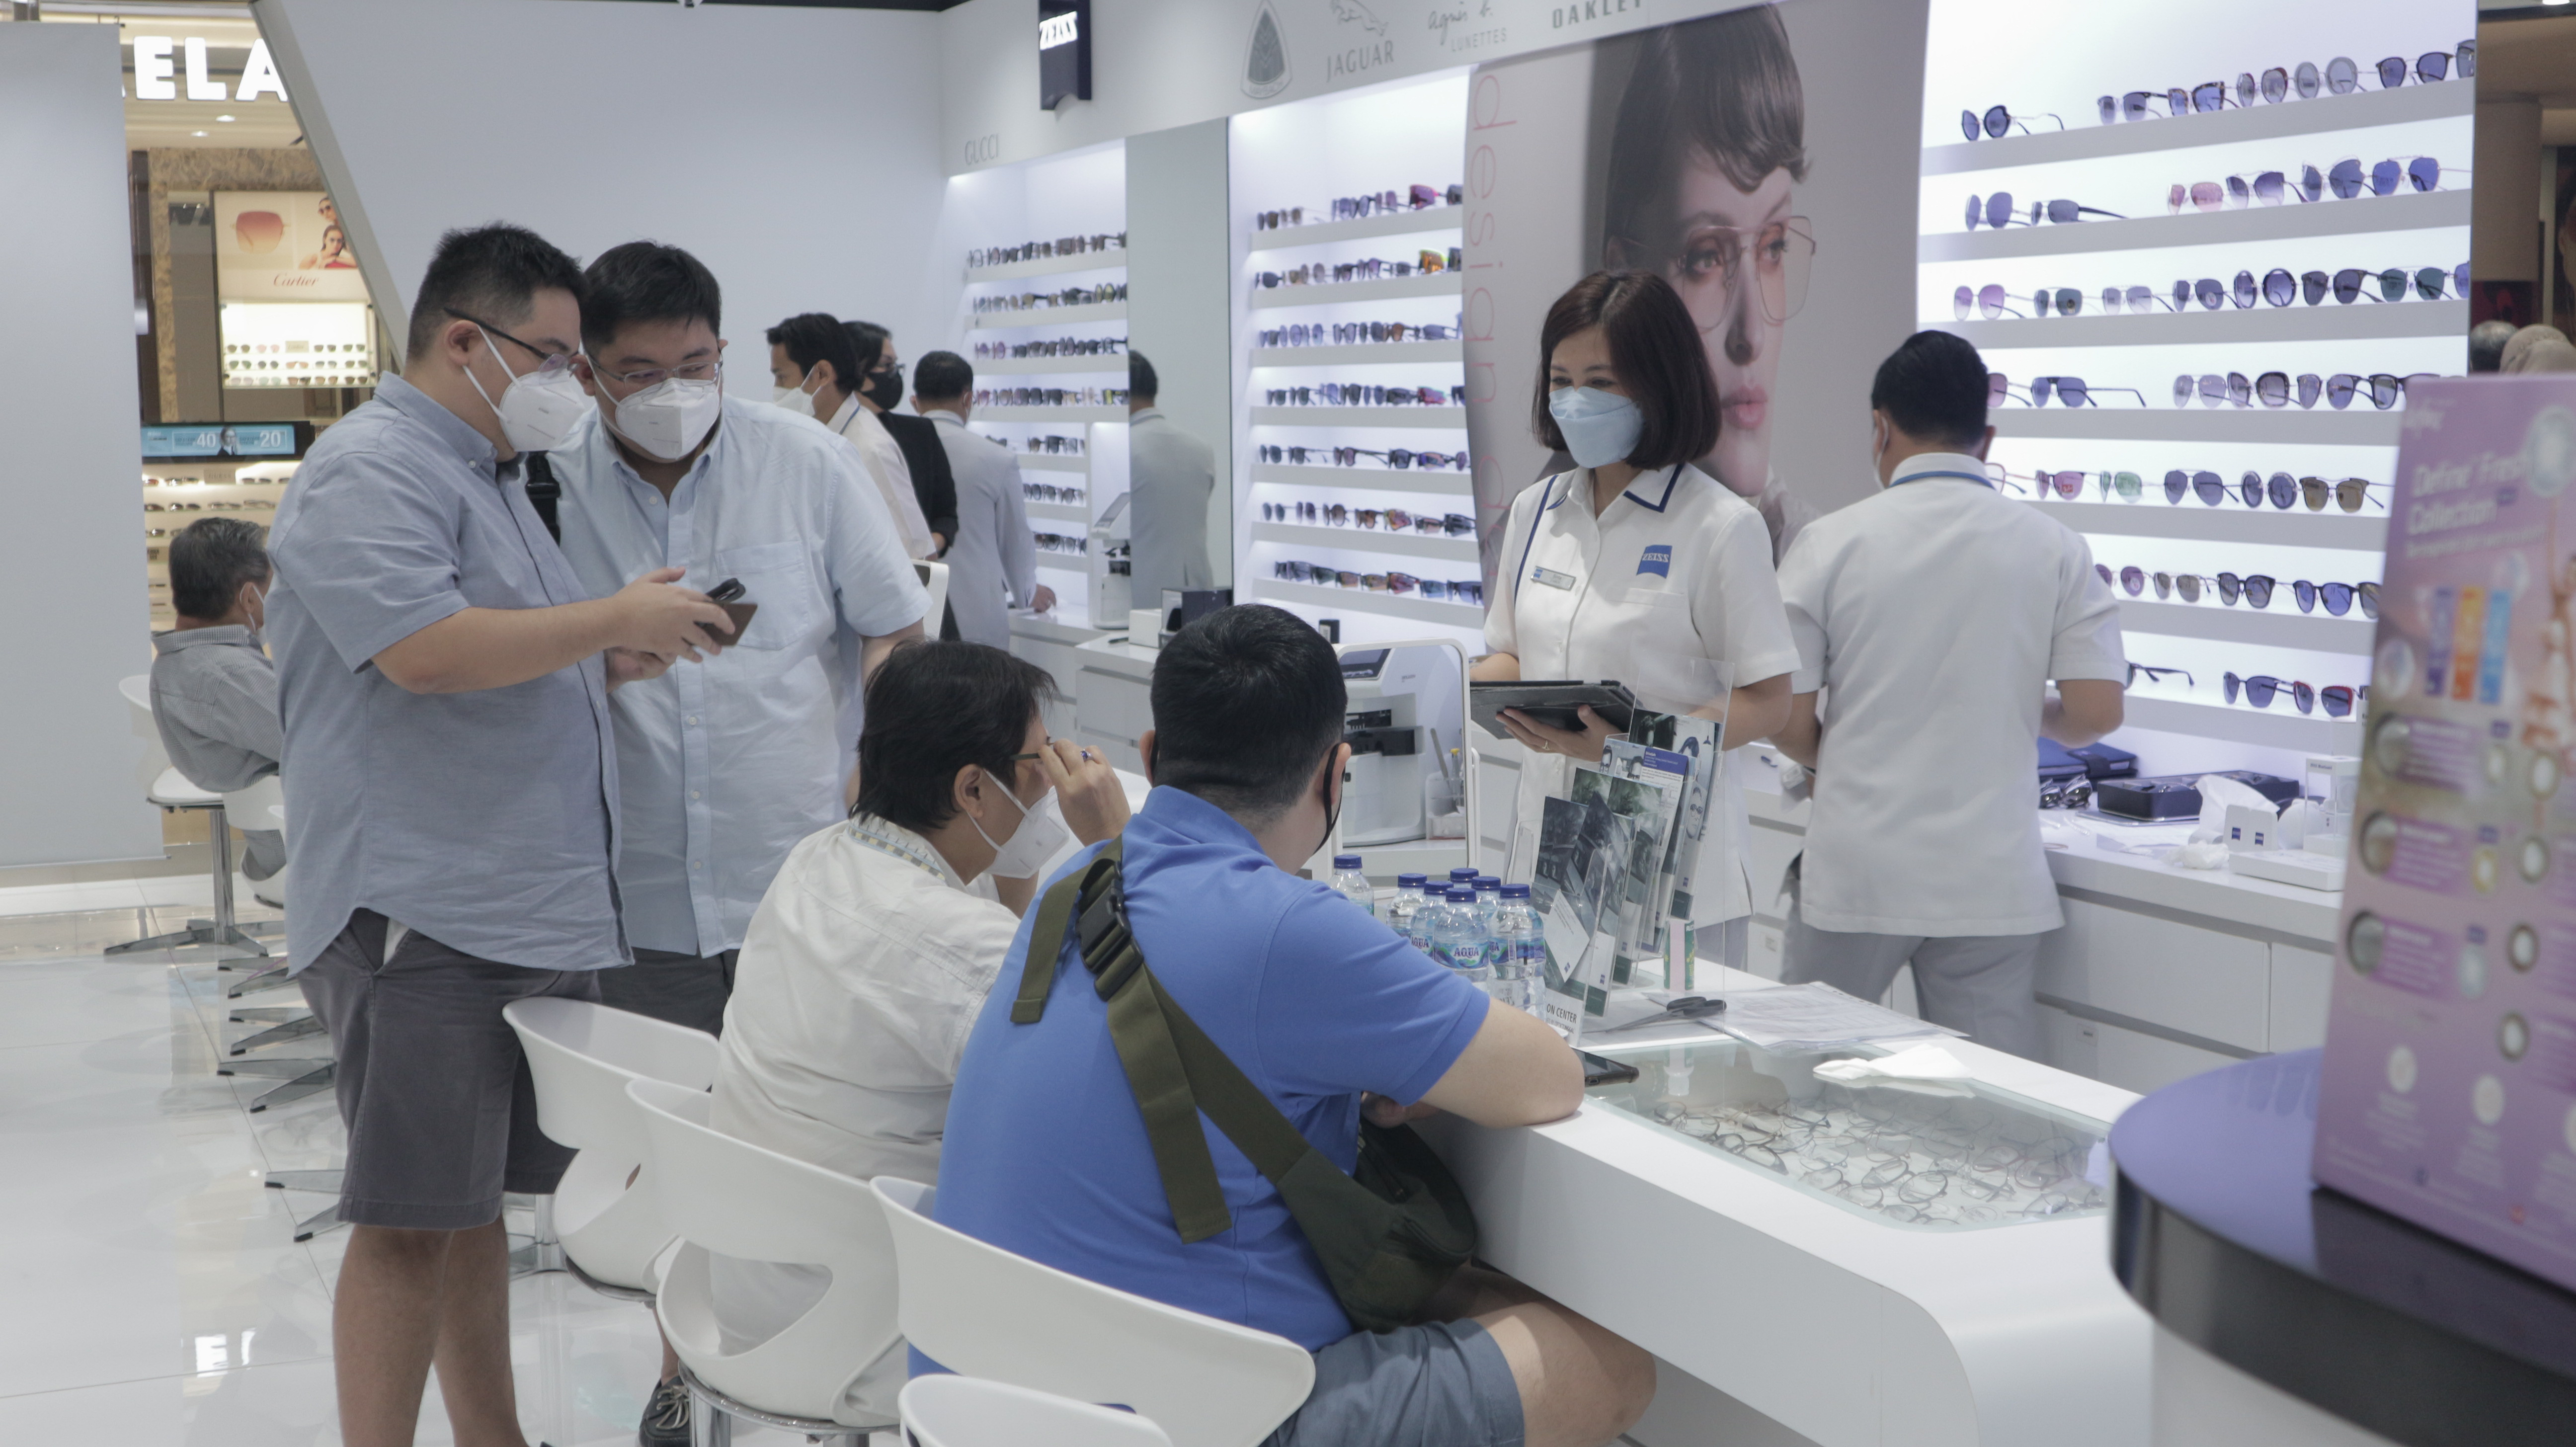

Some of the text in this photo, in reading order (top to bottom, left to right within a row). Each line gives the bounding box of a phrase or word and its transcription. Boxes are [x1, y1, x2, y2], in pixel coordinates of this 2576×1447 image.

[1450, 27, 1507, 52] LUNETTES
[122, 36, 289, 101] ELA
[1326, 40, 1394, 83] JAGUAR
[1463, 73, 1518, 404] design
[273, 272, 320, 287] Cartier
[197, 432, 217, 448] 40
[259, 430, 281, 448] 20
[1642, 553, 1669, 563] ZEISS
[1453, 947, 1479, 959] AQUA
[1547, 1003, 1555, 1015] ON
[1556, 1007, 1577, 1024] CENTER
